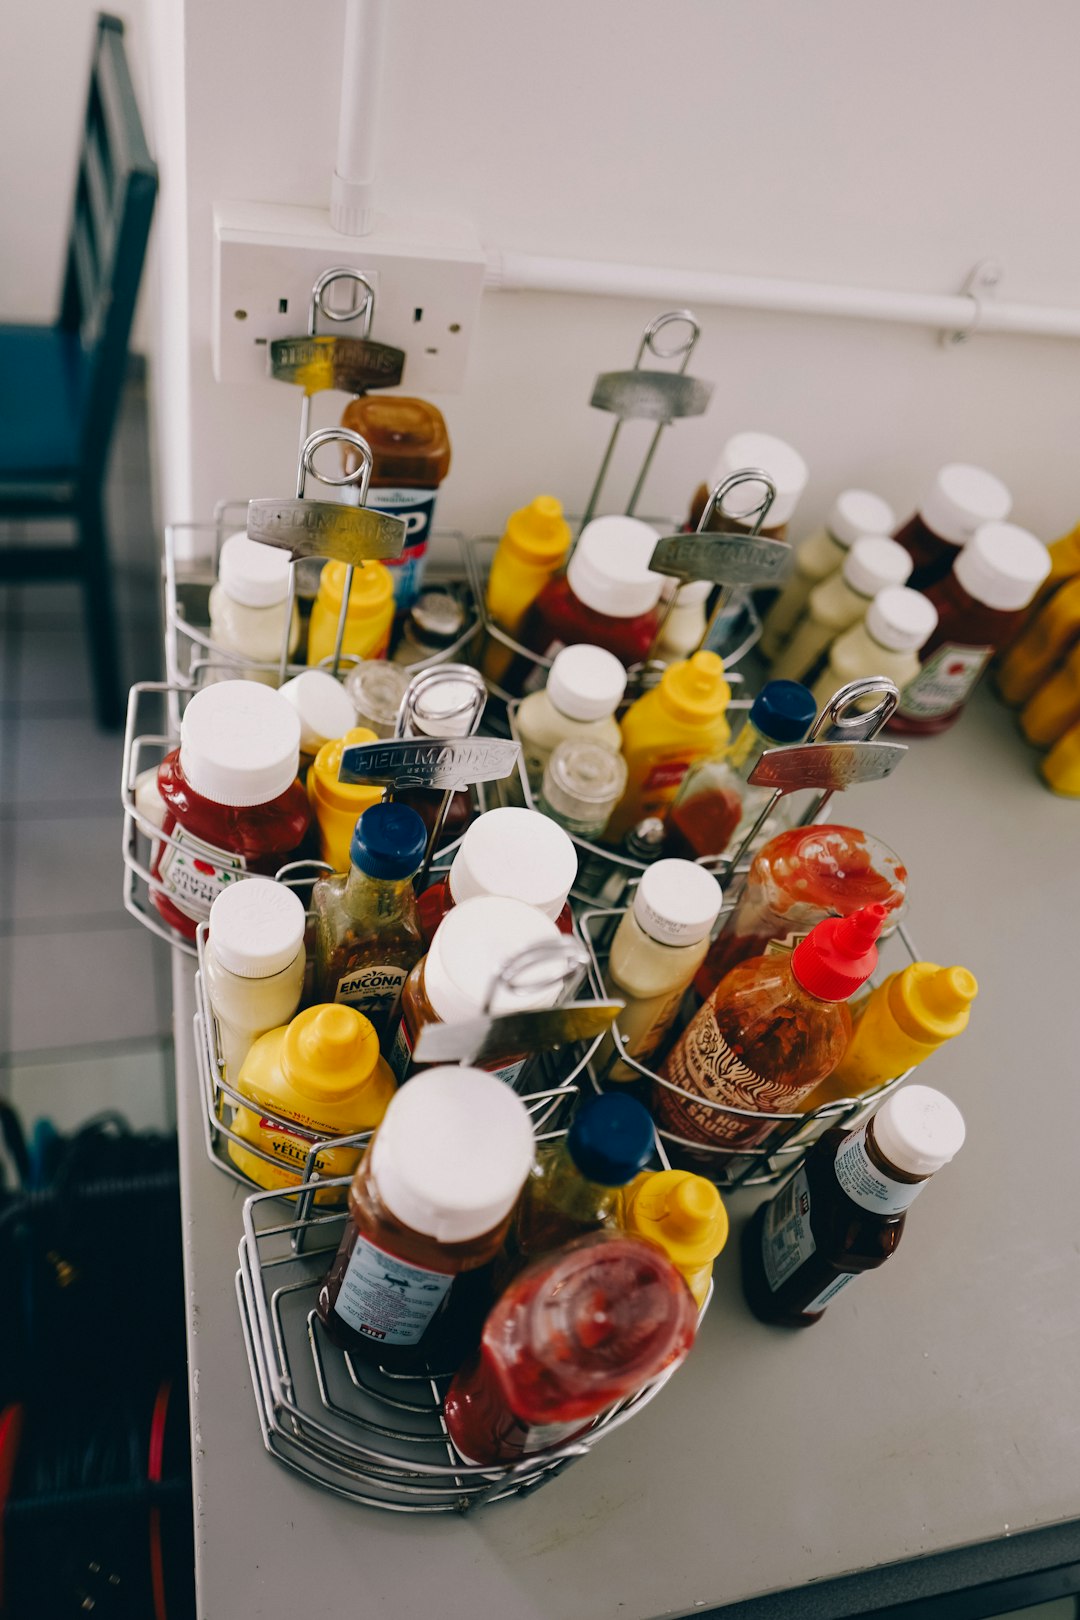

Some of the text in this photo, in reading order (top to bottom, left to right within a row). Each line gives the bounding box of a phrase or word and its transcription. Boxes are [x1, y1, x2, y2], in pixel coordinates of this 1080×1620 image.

[398, 511, 428, 535] P
[172, 872, 216, 902] MATO
[340, 976, 402, 993] ENCONA
[686, 1106, 739, 1140] SAUCE
[720, 1114, 751, 1132] HOT
